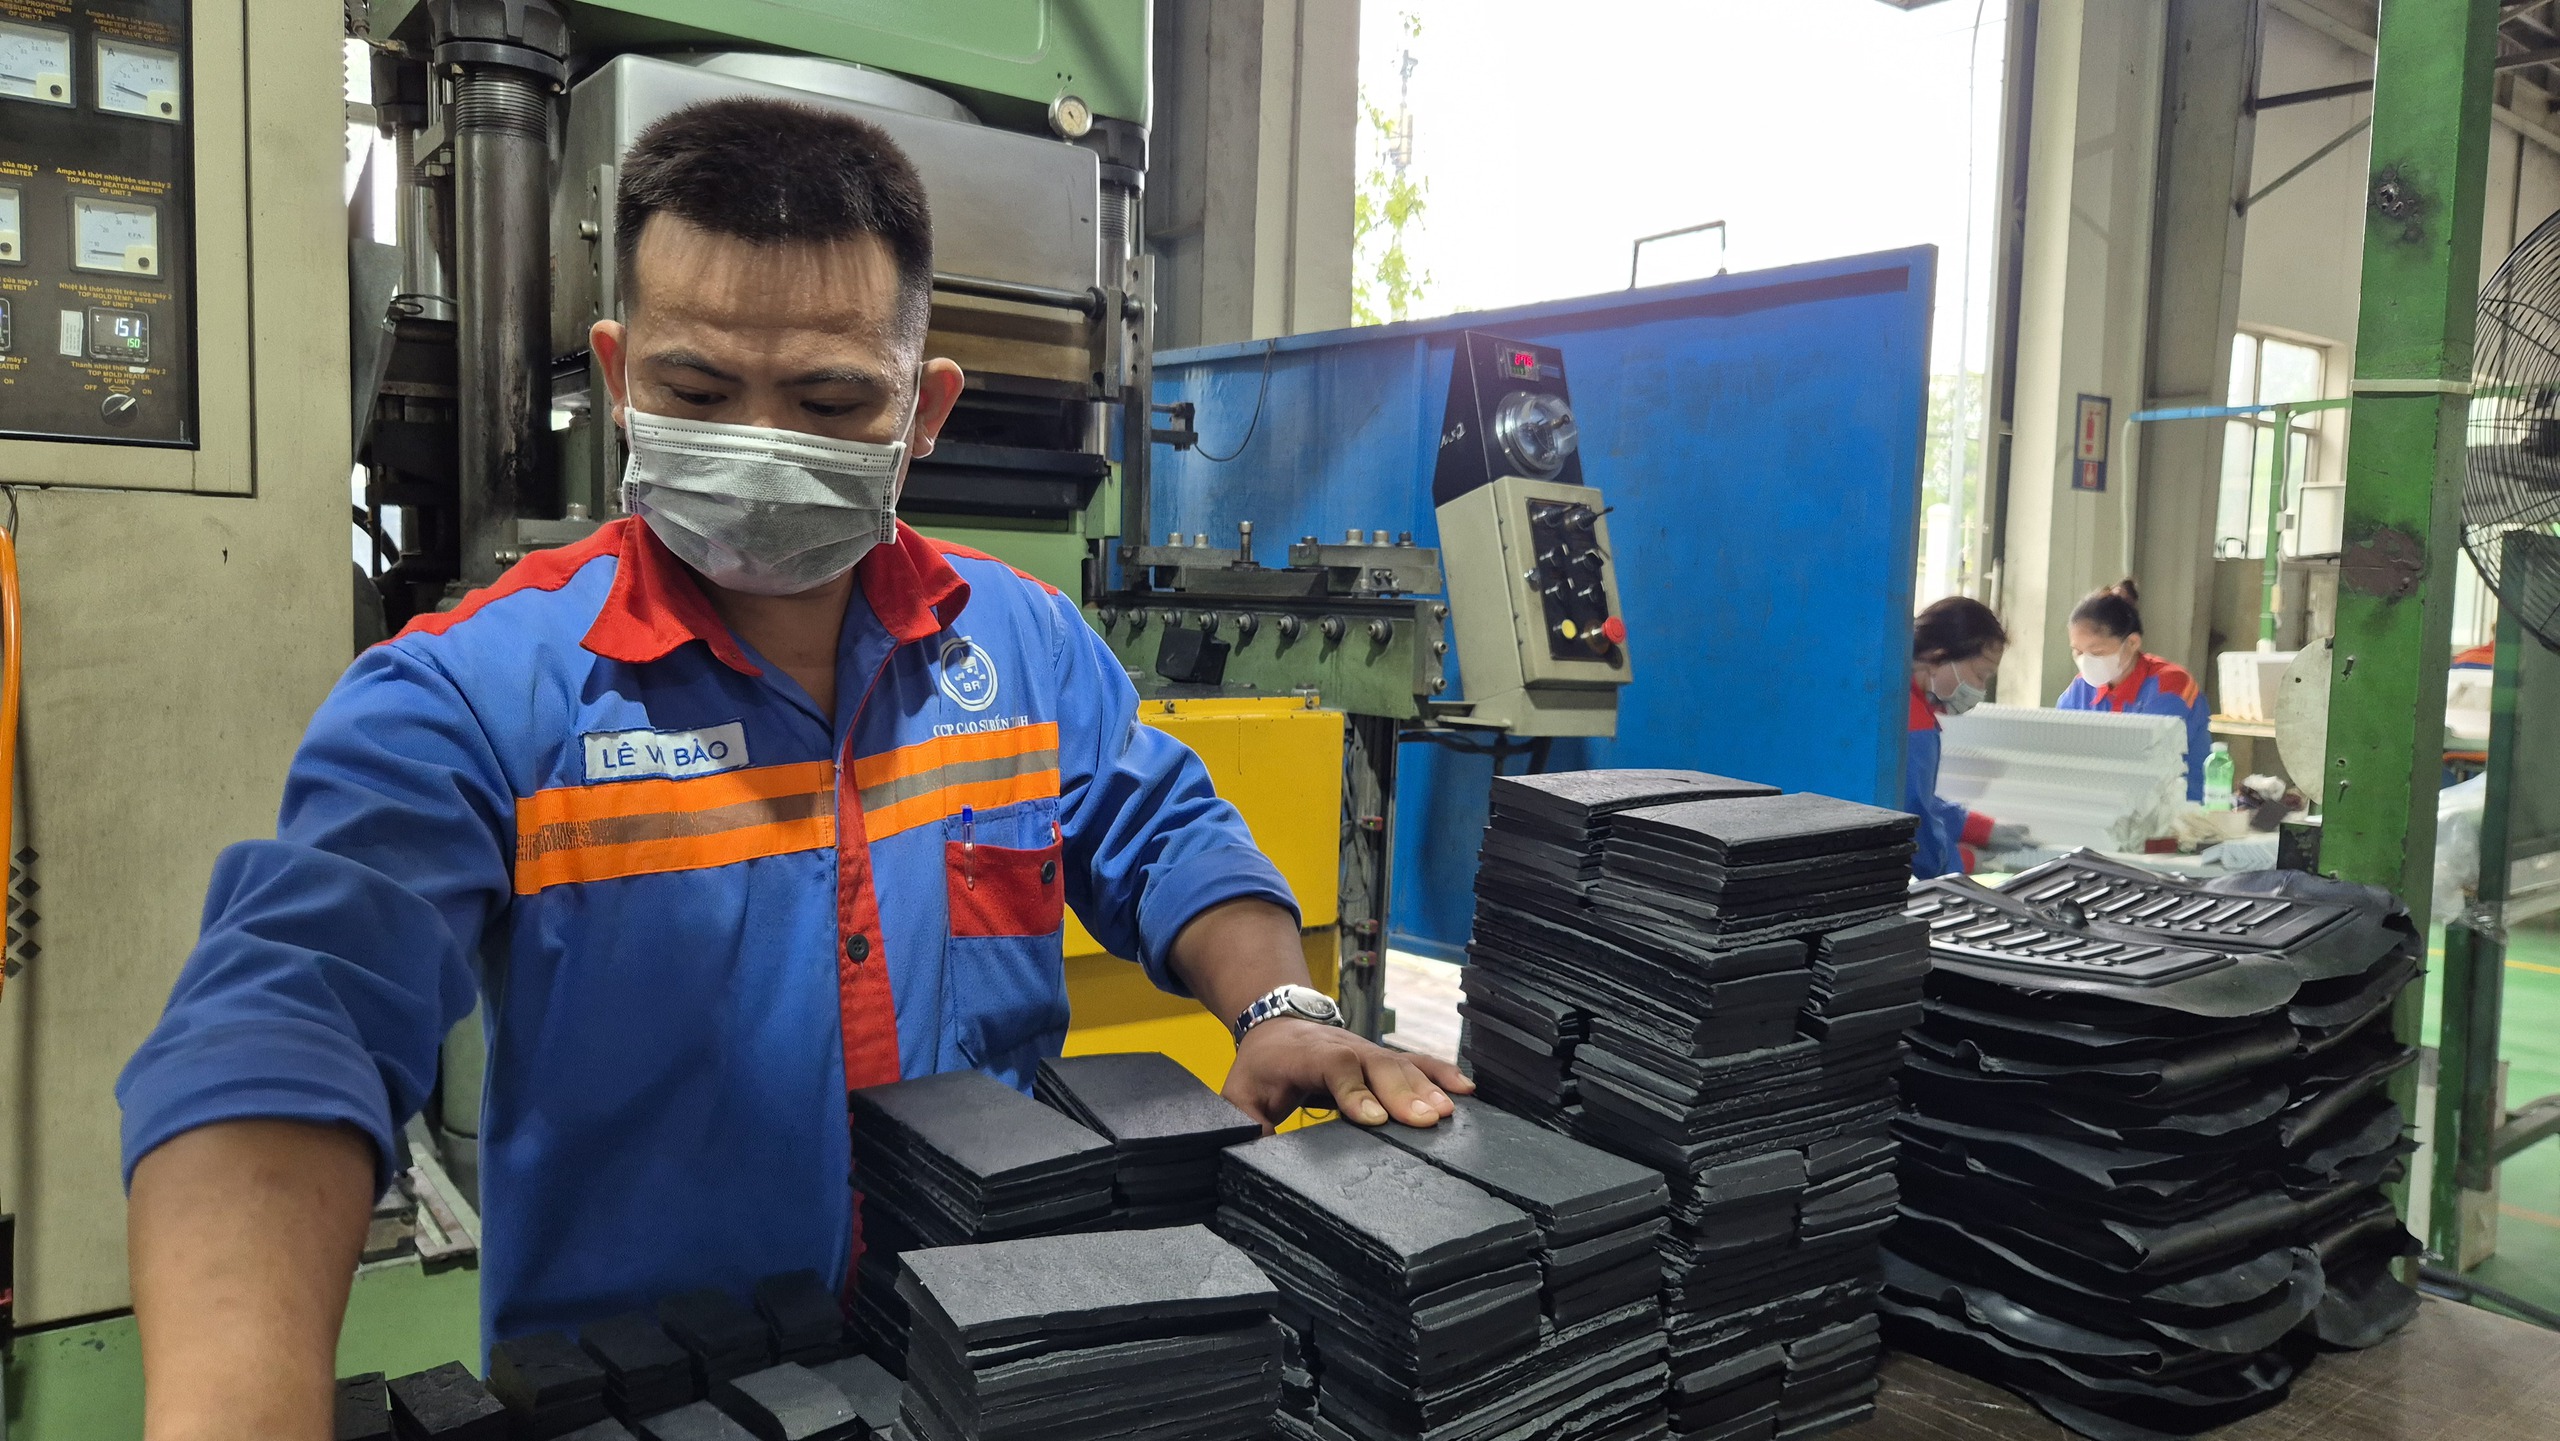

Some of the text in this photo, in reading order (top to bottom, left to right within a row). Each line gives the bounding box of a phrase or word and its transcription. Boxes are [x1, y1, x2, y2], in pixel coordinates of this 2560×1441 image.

[107, 48, 116, 57] A
[82, 178, 101, 186] MOLD
[103, 181, 130, 190] HEATER
[130, 185, 163, 194] AMMETER
[84, 204, 92, 214] A
[134, 296, 157, 304] METER
[115, 318, 140, 338] 151
[127, 338, 140, 348] 150
[962, 680, 980, 692] BR
[956, 722, 978, 734] CAO
[602, 741, 636, 769] LÊ
[673, 738, 729, 767] BẢO
